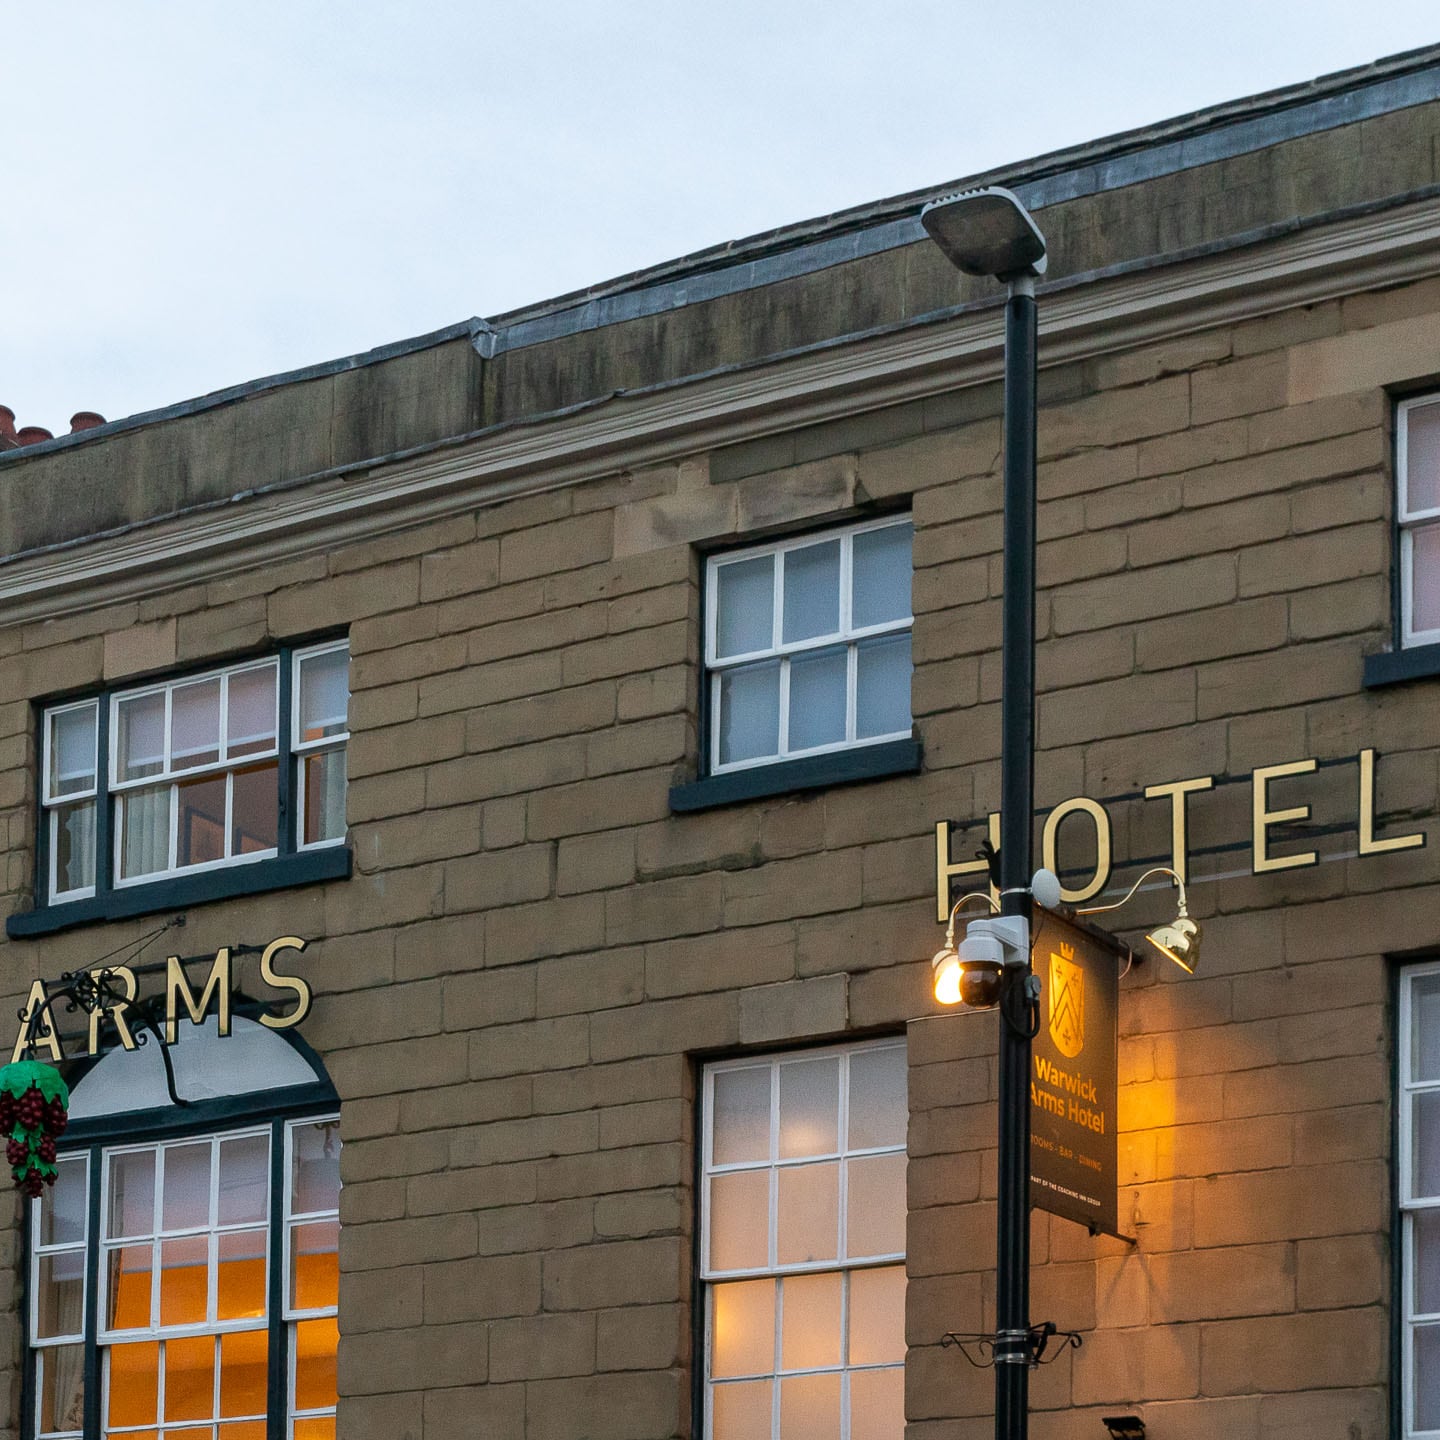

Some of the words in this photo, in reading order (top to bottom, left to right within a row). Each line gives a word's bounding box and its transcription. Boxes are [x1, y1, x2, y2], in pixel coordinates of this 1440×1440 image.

[11, 935, 313, 1063] ARMS
[935, 748, 1426, 924] HOTEL
[1035, 1055, 1097, 1104] Warwick
[1068, 1098, 1105, 1134] Hotel
[1049, 1182, 1057, 1191] THE
[1057, 1185, 1079, 1199] COACHING
[1079, 1194, 1087, 1202] INN
